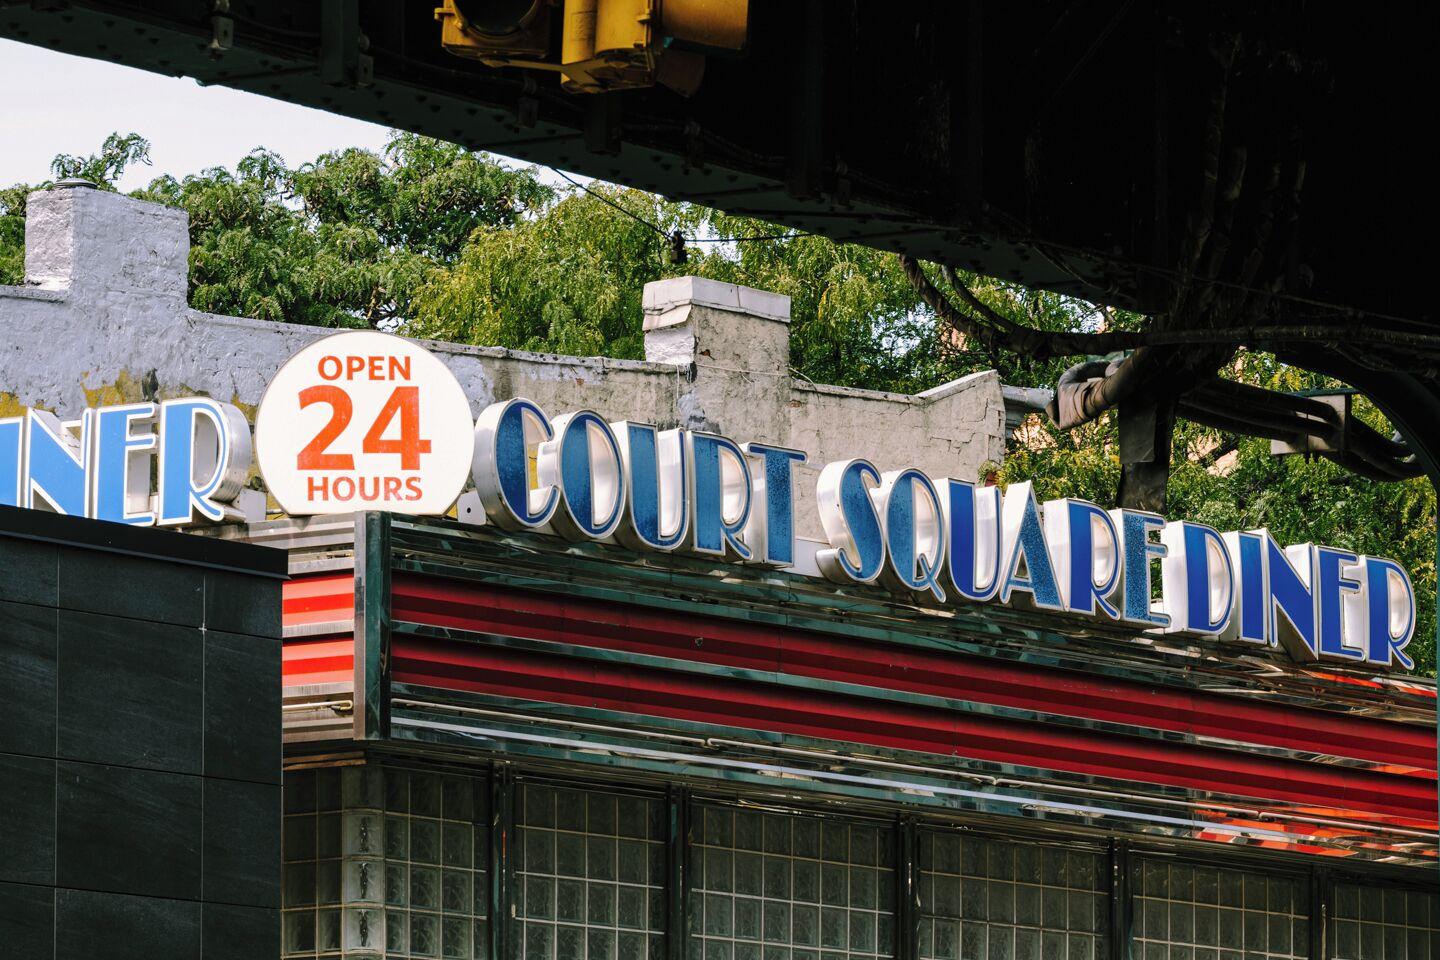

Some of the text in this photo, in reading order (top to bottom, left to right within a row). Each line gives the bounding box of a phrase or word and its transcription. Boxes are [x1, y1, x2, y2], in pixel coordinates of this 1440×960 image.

[318, 355, 411, 381] OPEN
[297, 385, 431, 470] 24
[307, 476, 423, 501] HOURS
[494, 397, 1416, 671] COURT SQUARE DINER
